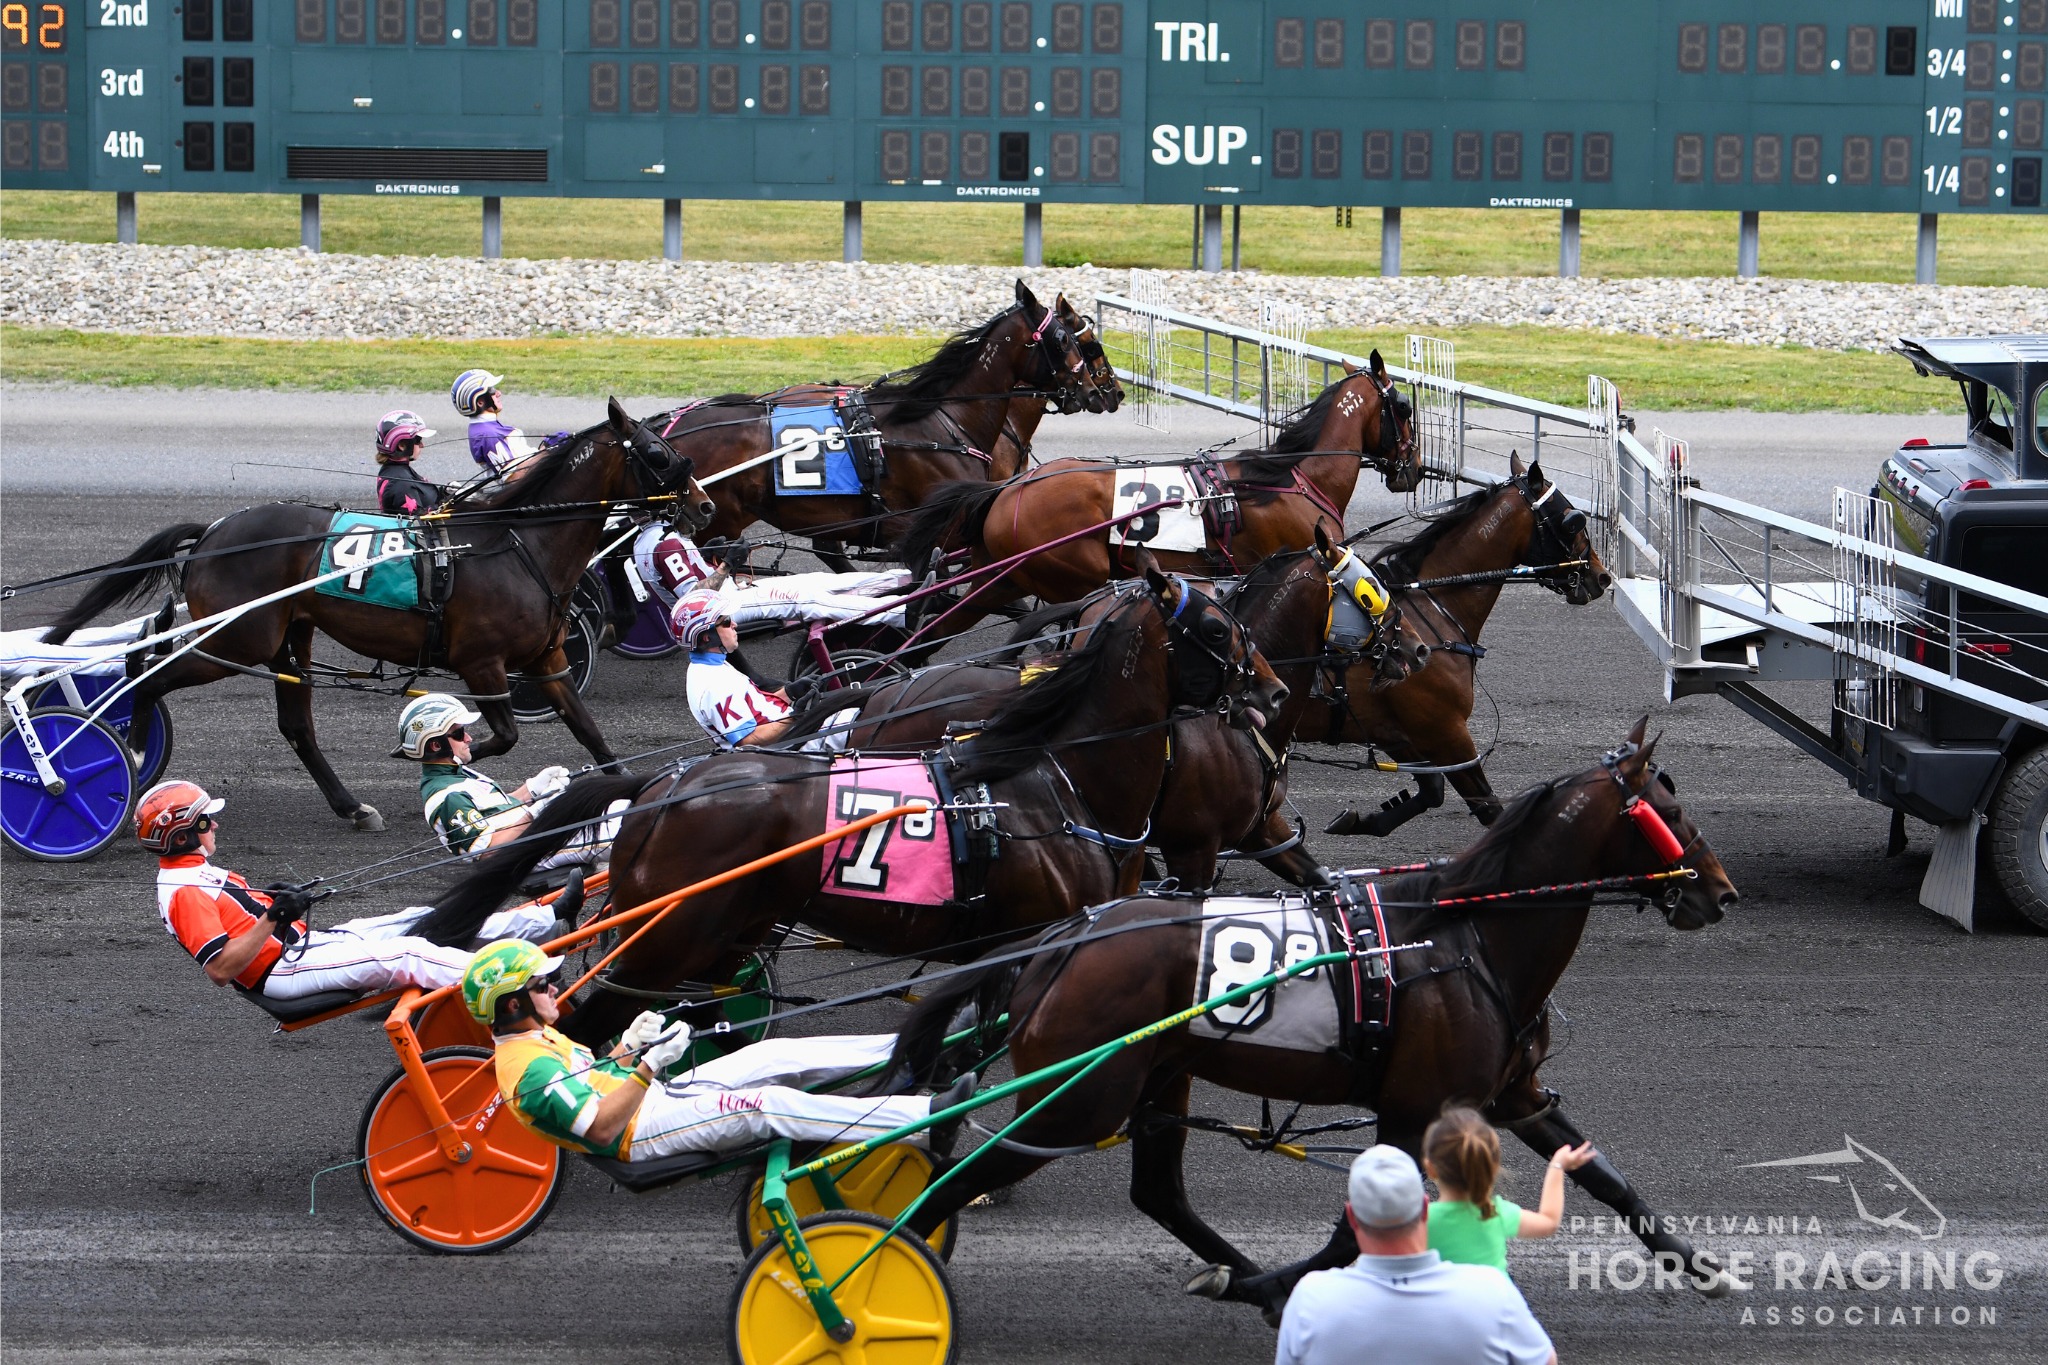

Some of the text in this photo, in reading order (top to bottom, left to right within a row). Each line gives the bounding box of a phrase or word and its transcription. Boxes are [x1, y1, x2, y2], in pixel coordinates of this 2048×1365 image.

[2, 3, 65, 49] 92
[100, 0, 149, 26] 2nd
[1154, 21, 1230, 62] TRI.
[1927, 48, 1966, 79] 3/4
[101, 68, 144, 97] 3rd
[1926, 106, 1962, 137] 1/2
[103, 130, 144, 158] 4th
[1151, 124, 1262, 165] SUP.
[375, 184, 460, 195] DAKTRONICS
[956, 186, 1041, 197] DAKTRONICS
[1923, 165, 1960, 196] 1/4
[1489, 197, 1574, 208] DAKTRONICS
[778, 425, 824, 488] 2
[1117, 482, 1184, 542] 3 8
[331, 524, 377, 592] 4
[380, 531, 405, 558] 8
[664, 552, 690, 581] B
[715, 694, 742, 728] K
[449, 809, 488, 835] YG
[838, 788, 936, 889] 7 8
[1206, 921, 1319, 1030] 8 8
[807, 1142, 868, 1173] TIM TETRICK
